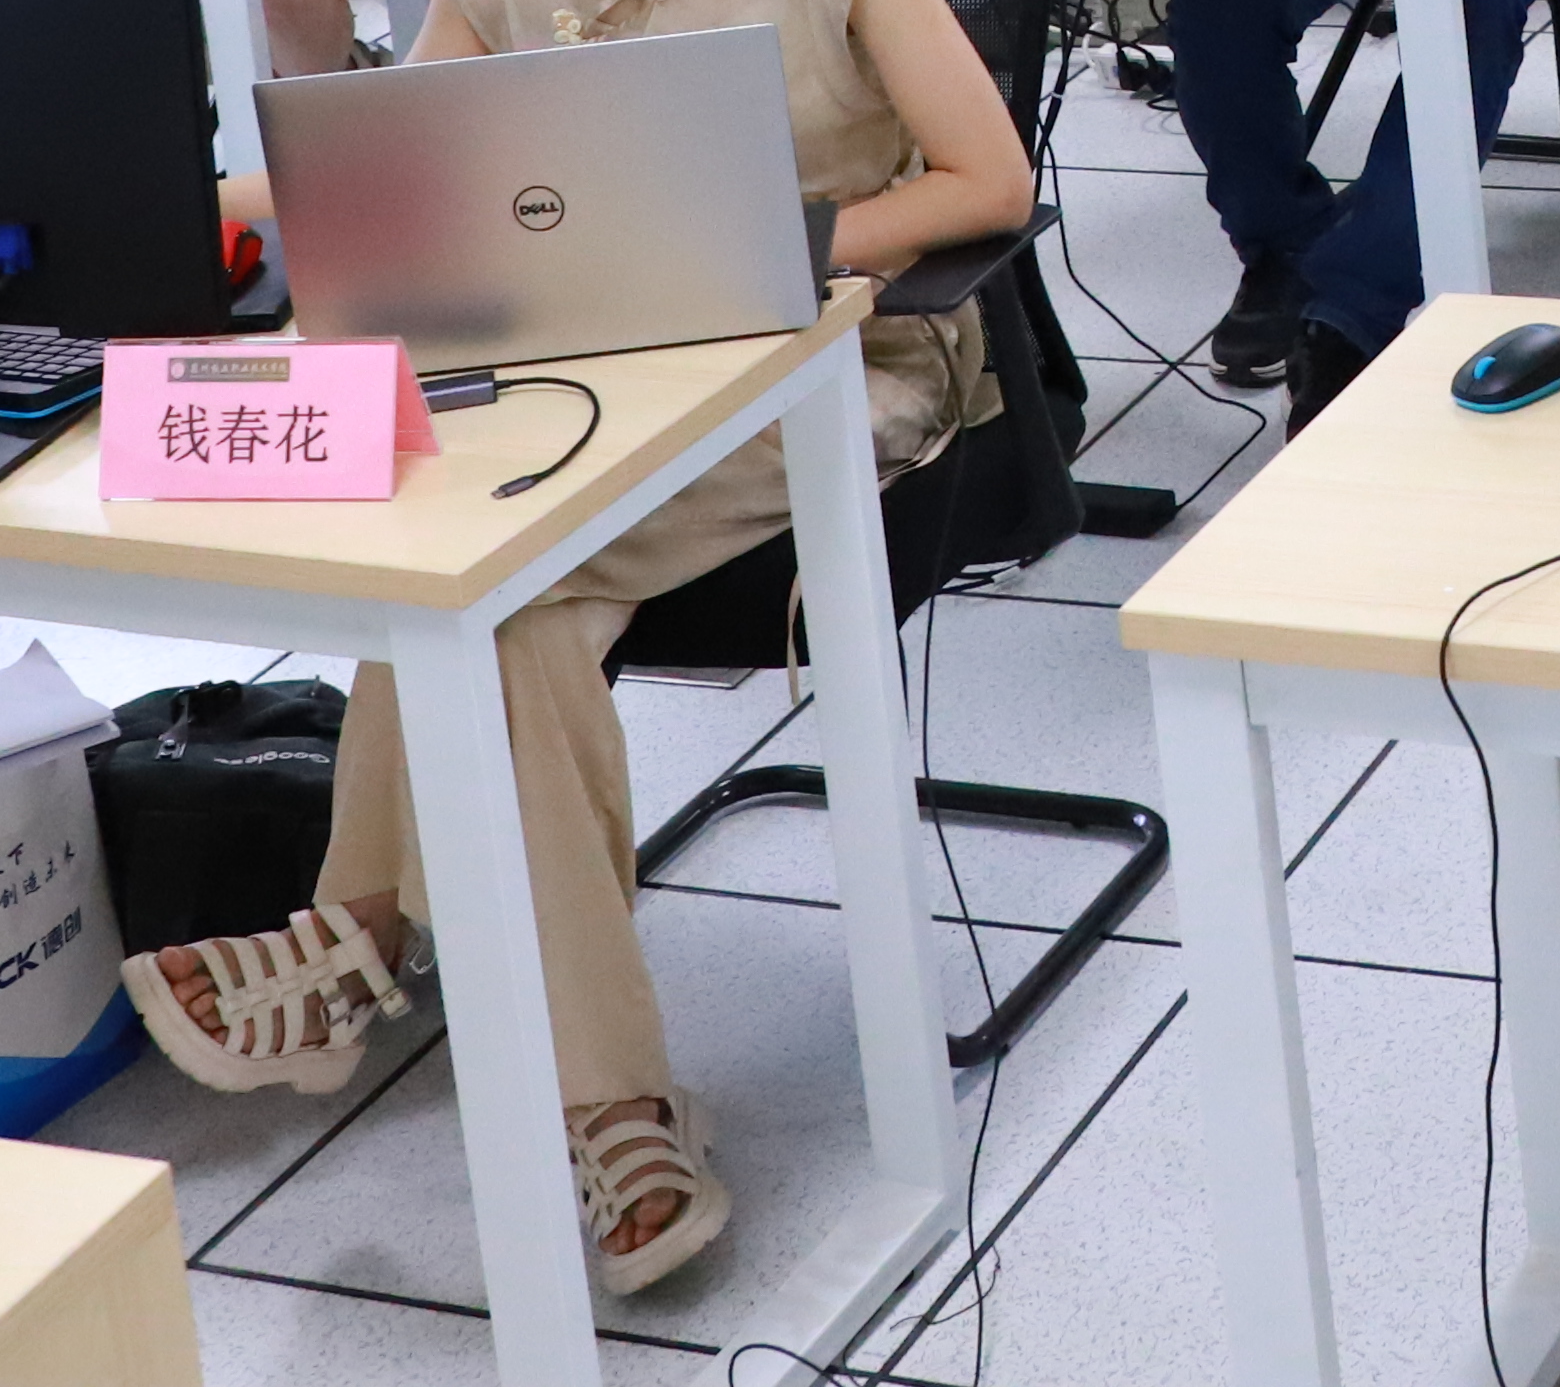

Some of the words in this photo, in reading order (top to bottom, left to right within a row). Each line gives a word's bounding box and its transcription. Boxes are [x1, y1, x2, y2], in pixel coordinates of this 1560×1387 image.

[520, 202, 561, 216] DELL
[156, 403, 331, 465] 钱春花
[40, 905, 83, 961] 德创
